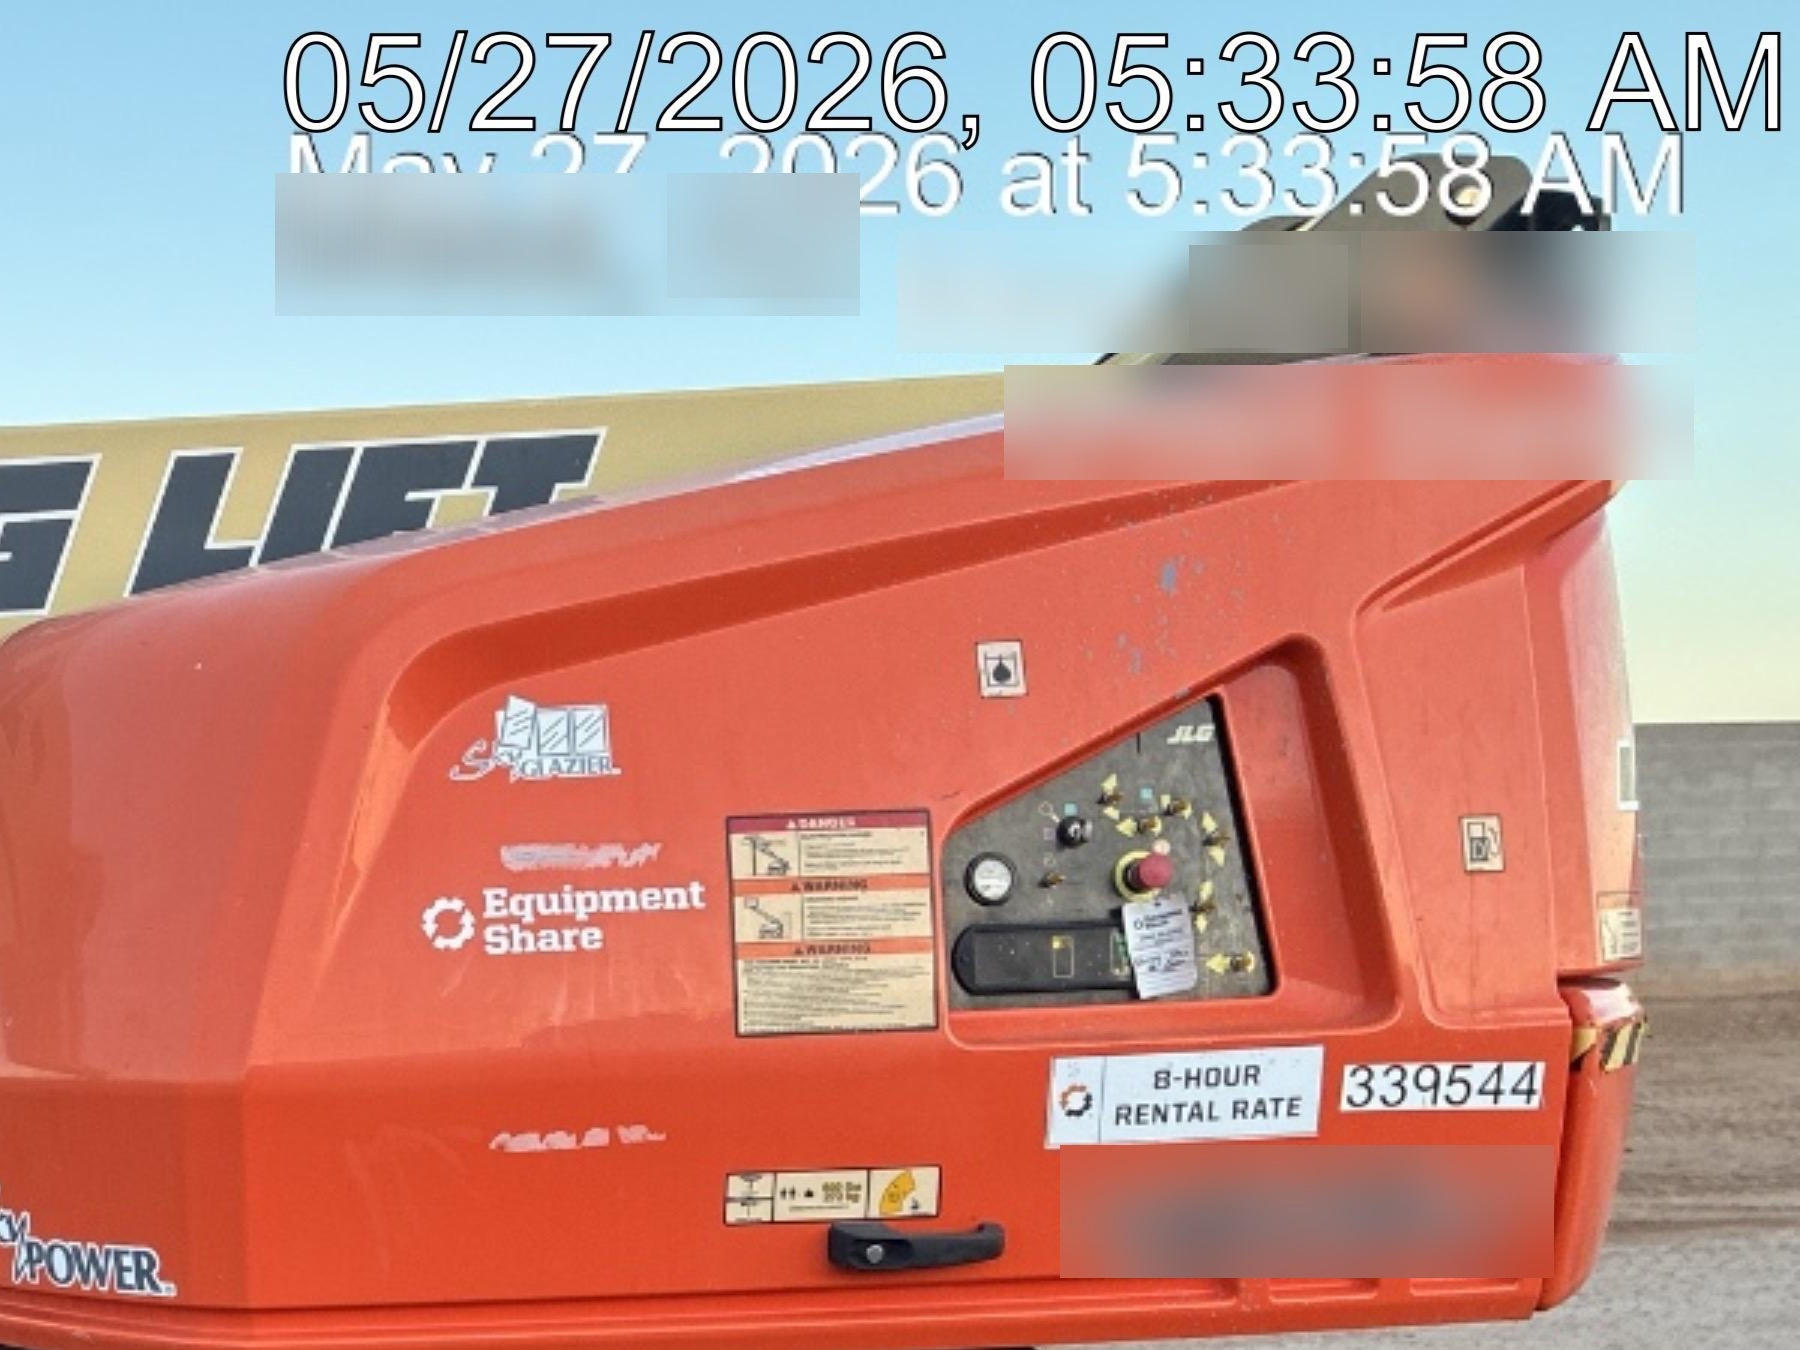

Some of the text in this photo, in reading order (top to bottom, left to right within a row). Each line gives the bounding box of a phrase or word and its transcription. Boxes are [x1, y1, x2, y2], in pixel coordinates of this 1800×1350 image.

[124, 427, 606, 597] LIFT
[1167, 724, 1216, 744] JLG
[483, 881, 706, 923] Equipment
[483, 924, 604, 955] Share
[1153, 1064, 1262, 1091] 8-HOUR
[1345, 1064, 1540, 1108] 339544
[1114, 1095, 1304, 1127] RENTAL RATE
[23, 1239, 163, 1294] POWER
